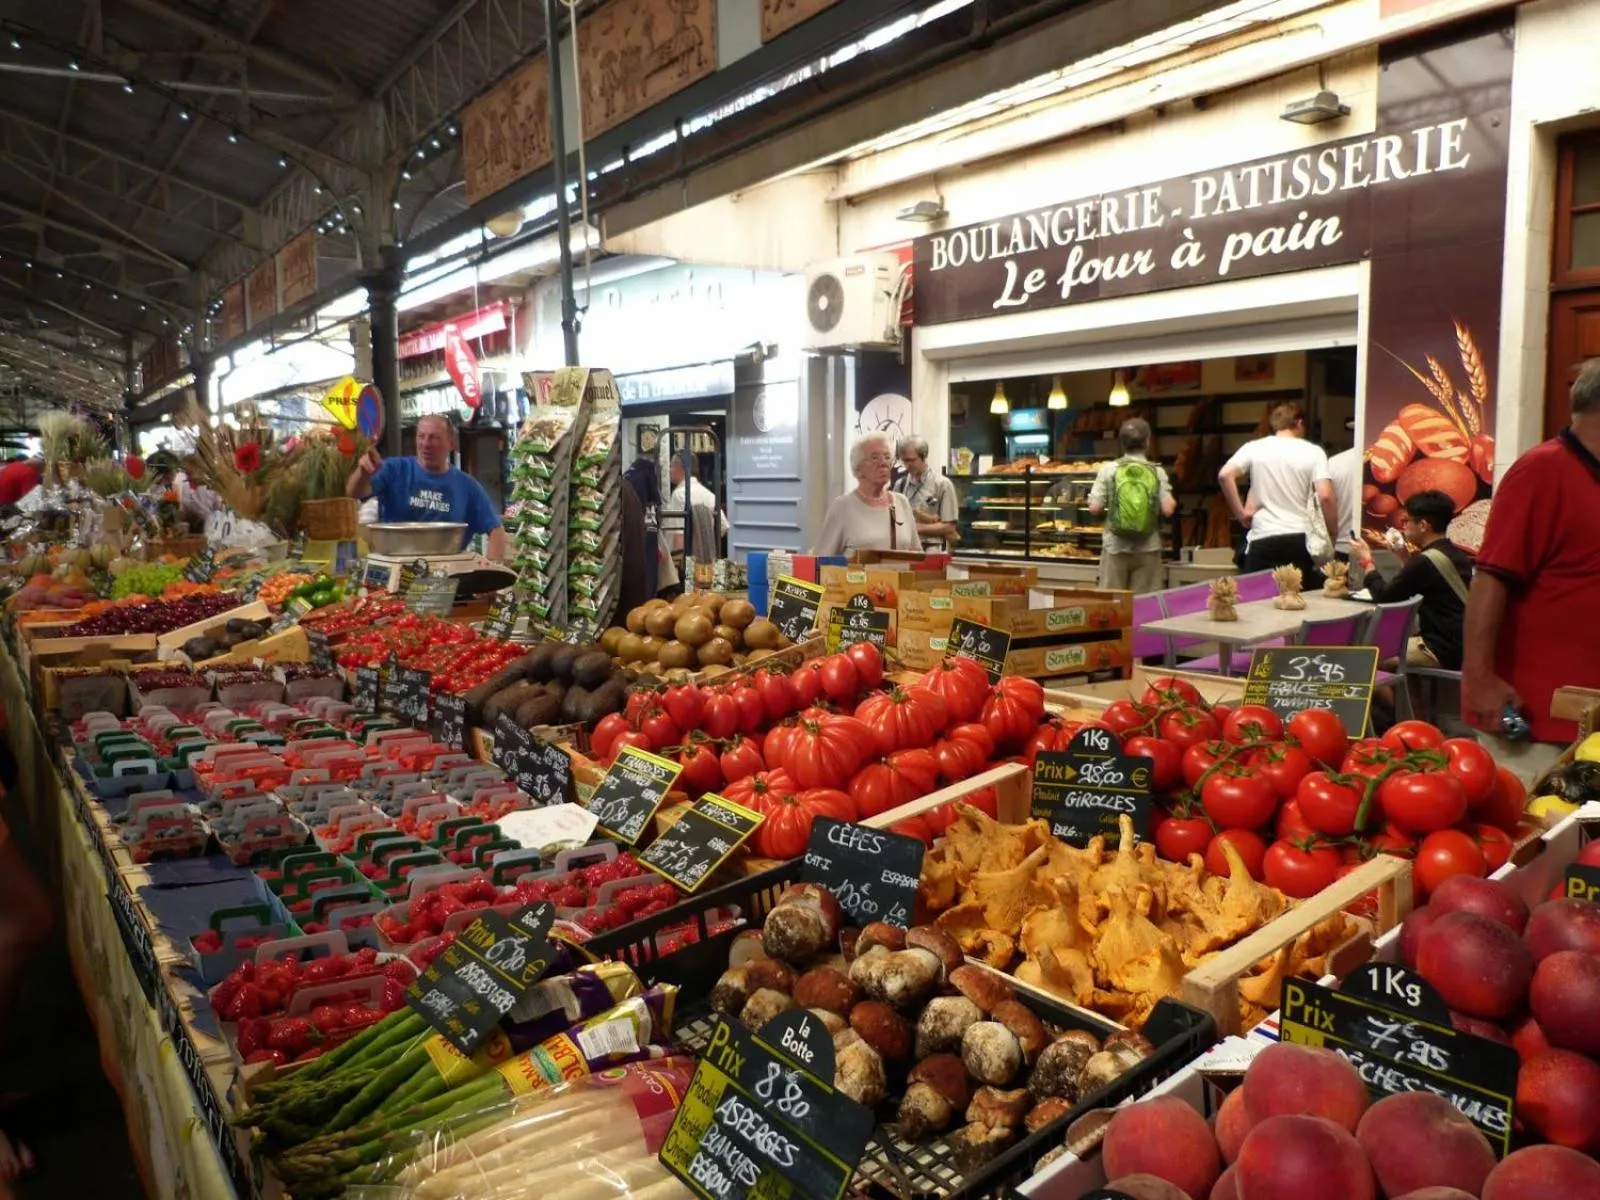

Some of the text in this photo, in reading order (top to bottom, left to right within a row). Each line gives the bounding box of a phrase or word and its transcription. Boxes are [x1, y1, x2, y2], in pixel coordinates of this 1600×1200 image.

[929, 186, 1164, 272] BOULANGERIE
[1191, 117, 1472, 219] PATISSERIE
[992, 210, 1343, 308] Le four à pain
[409, 497, 450, 512] MISTAKES
[420, 490, 443, 501] MAKE
[1082, 729, 1110, 750] 1Kg
[1035, 760, 1064, 780] Prix
[463, 918, 488, 946] Prix
[1368, 967, 1422, 1007] 1Kg
[799, 1016, 811, 1038] la
[1285, 984, 1336, 1032] Prix
[706, 1021, 747, 1078] Prix
[781, 1027, 815, 1063] Botte
[715, 1095, 800, 1167] ASPERGES
[700, 1123, 762, 1186] BLANCHES
